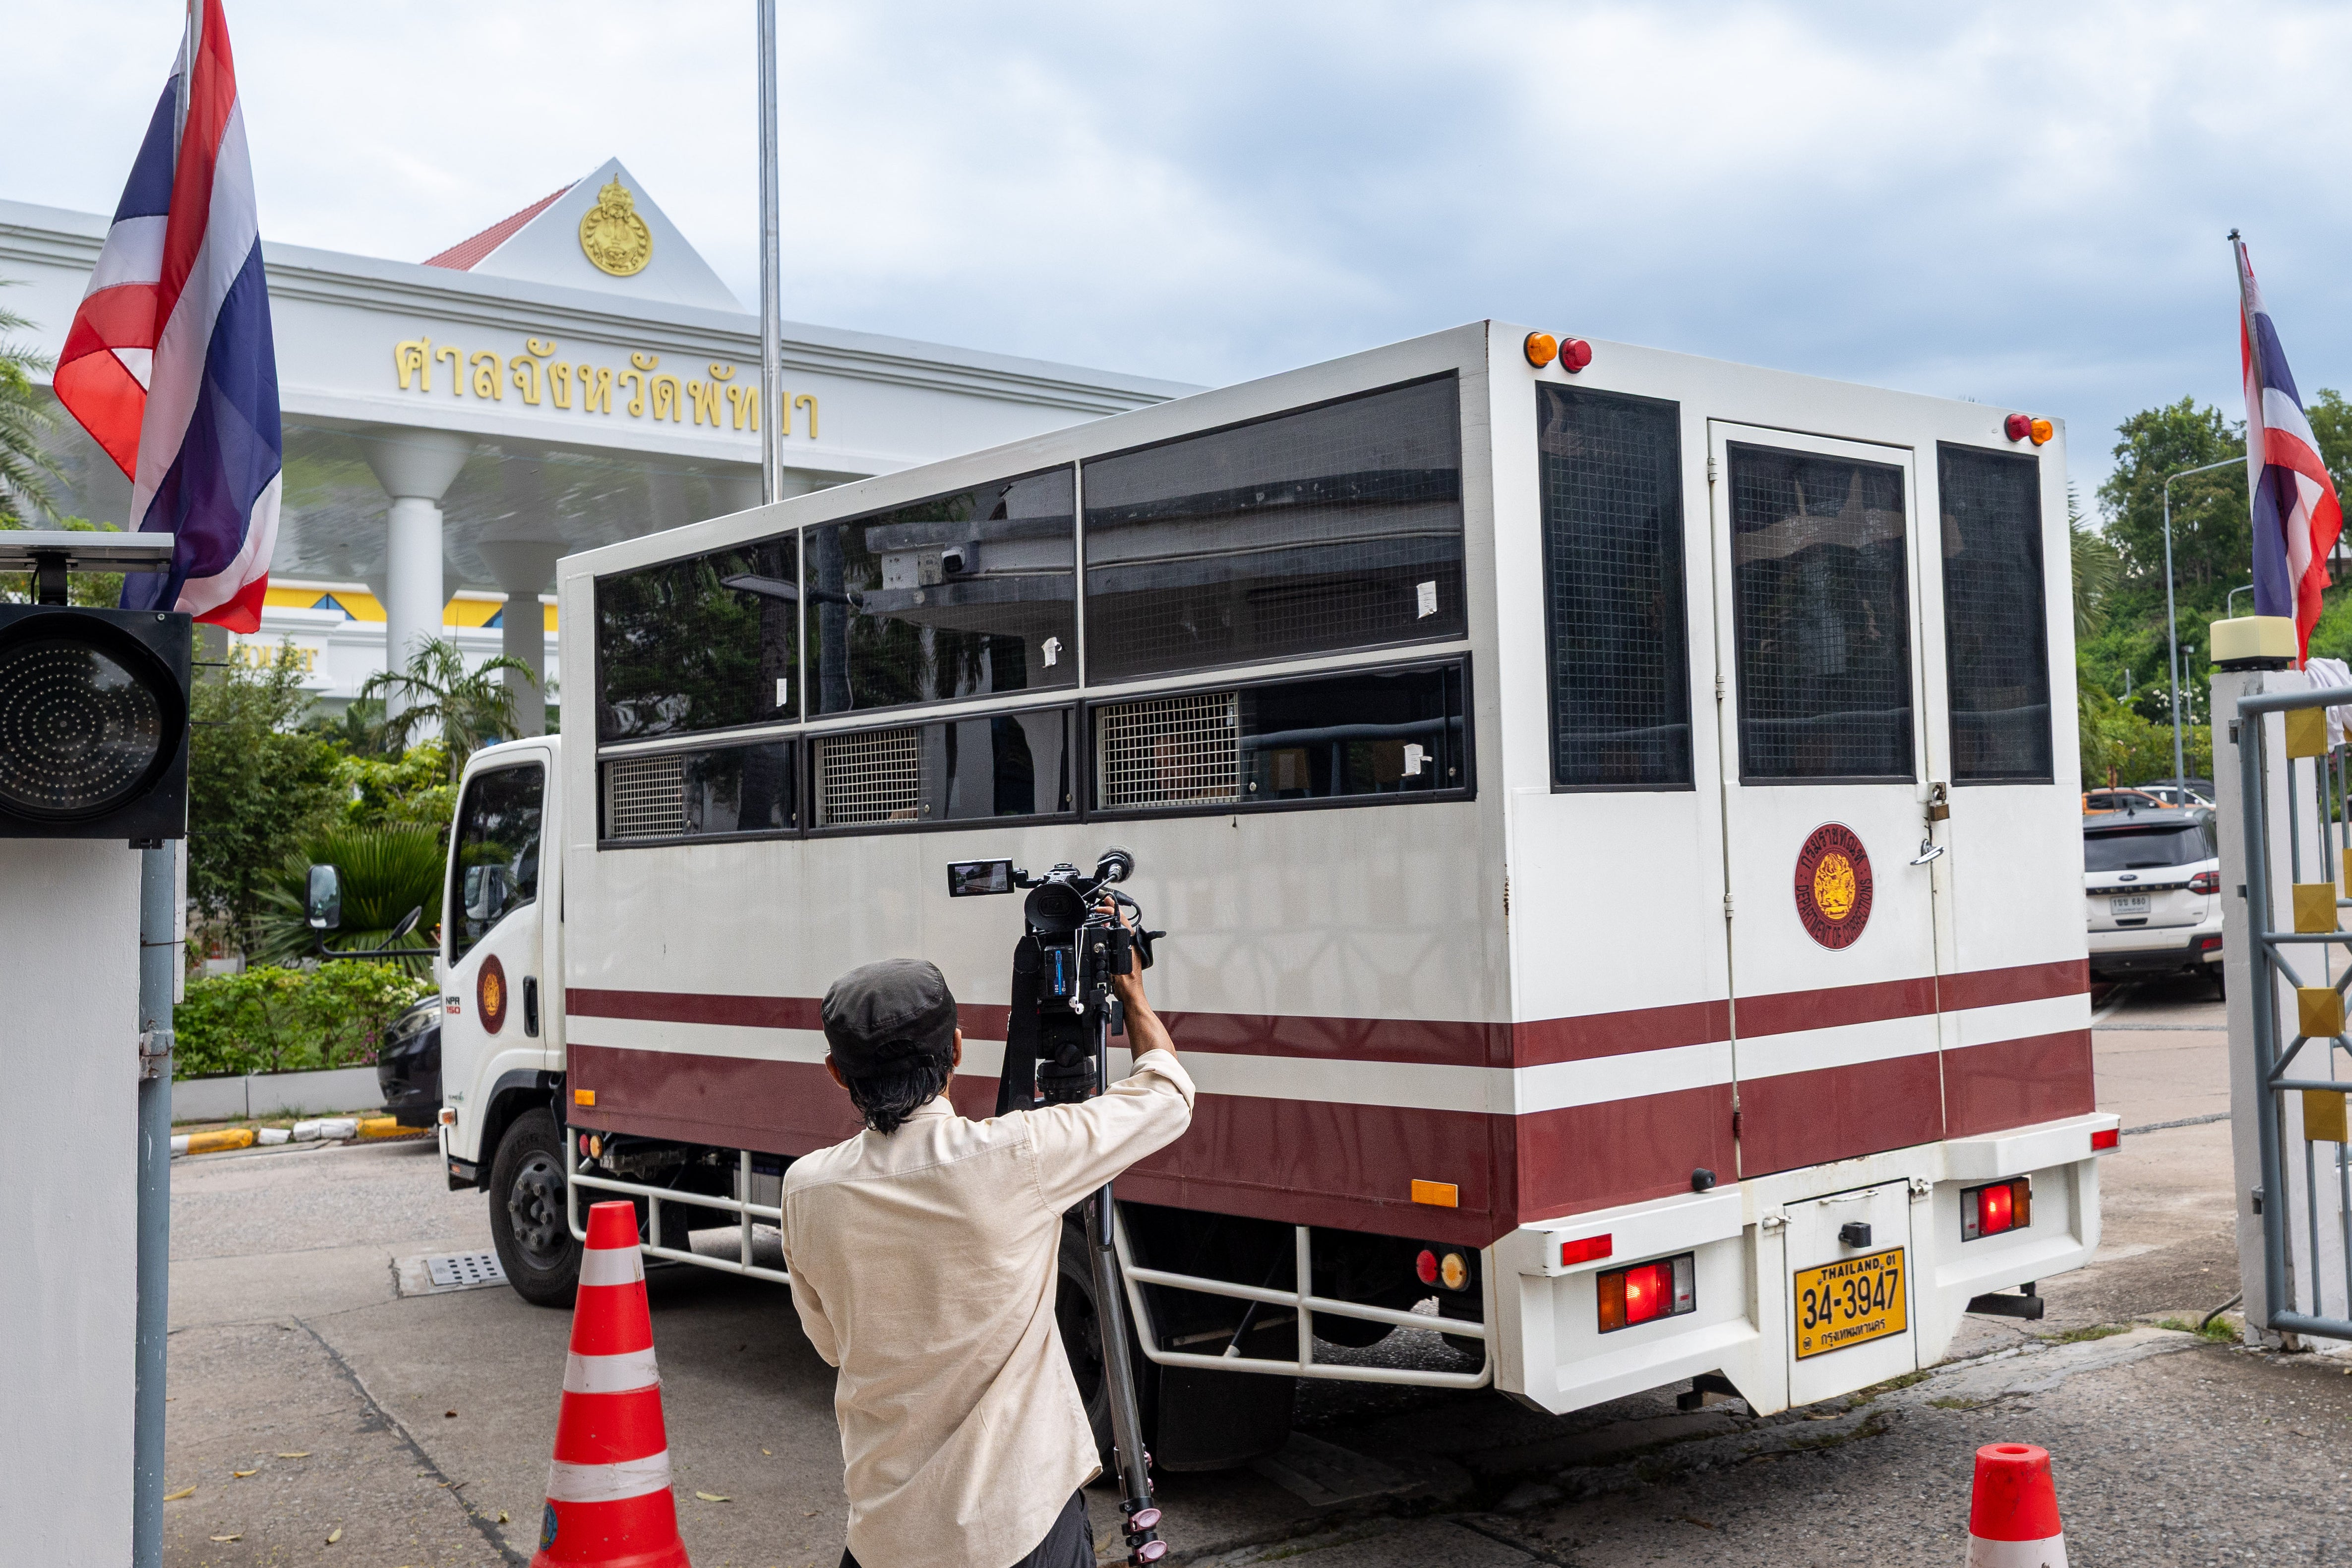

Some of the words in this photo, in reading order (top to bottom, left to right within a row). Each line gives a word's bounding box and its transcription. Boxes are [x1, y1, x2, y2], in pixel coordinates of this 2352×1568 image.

[2096, 883, 2176, 893] VEREST
[446, 996, 460, 1005] NPR
[1821, 1257, 1879, 1280] THAILAND
[1886, 1254, 1896, 1265] 01
[1803, 1268, 1898, 1330] 34-3947
[1821, 1318, 1886, 1347] กรุงเทพมหานคร
